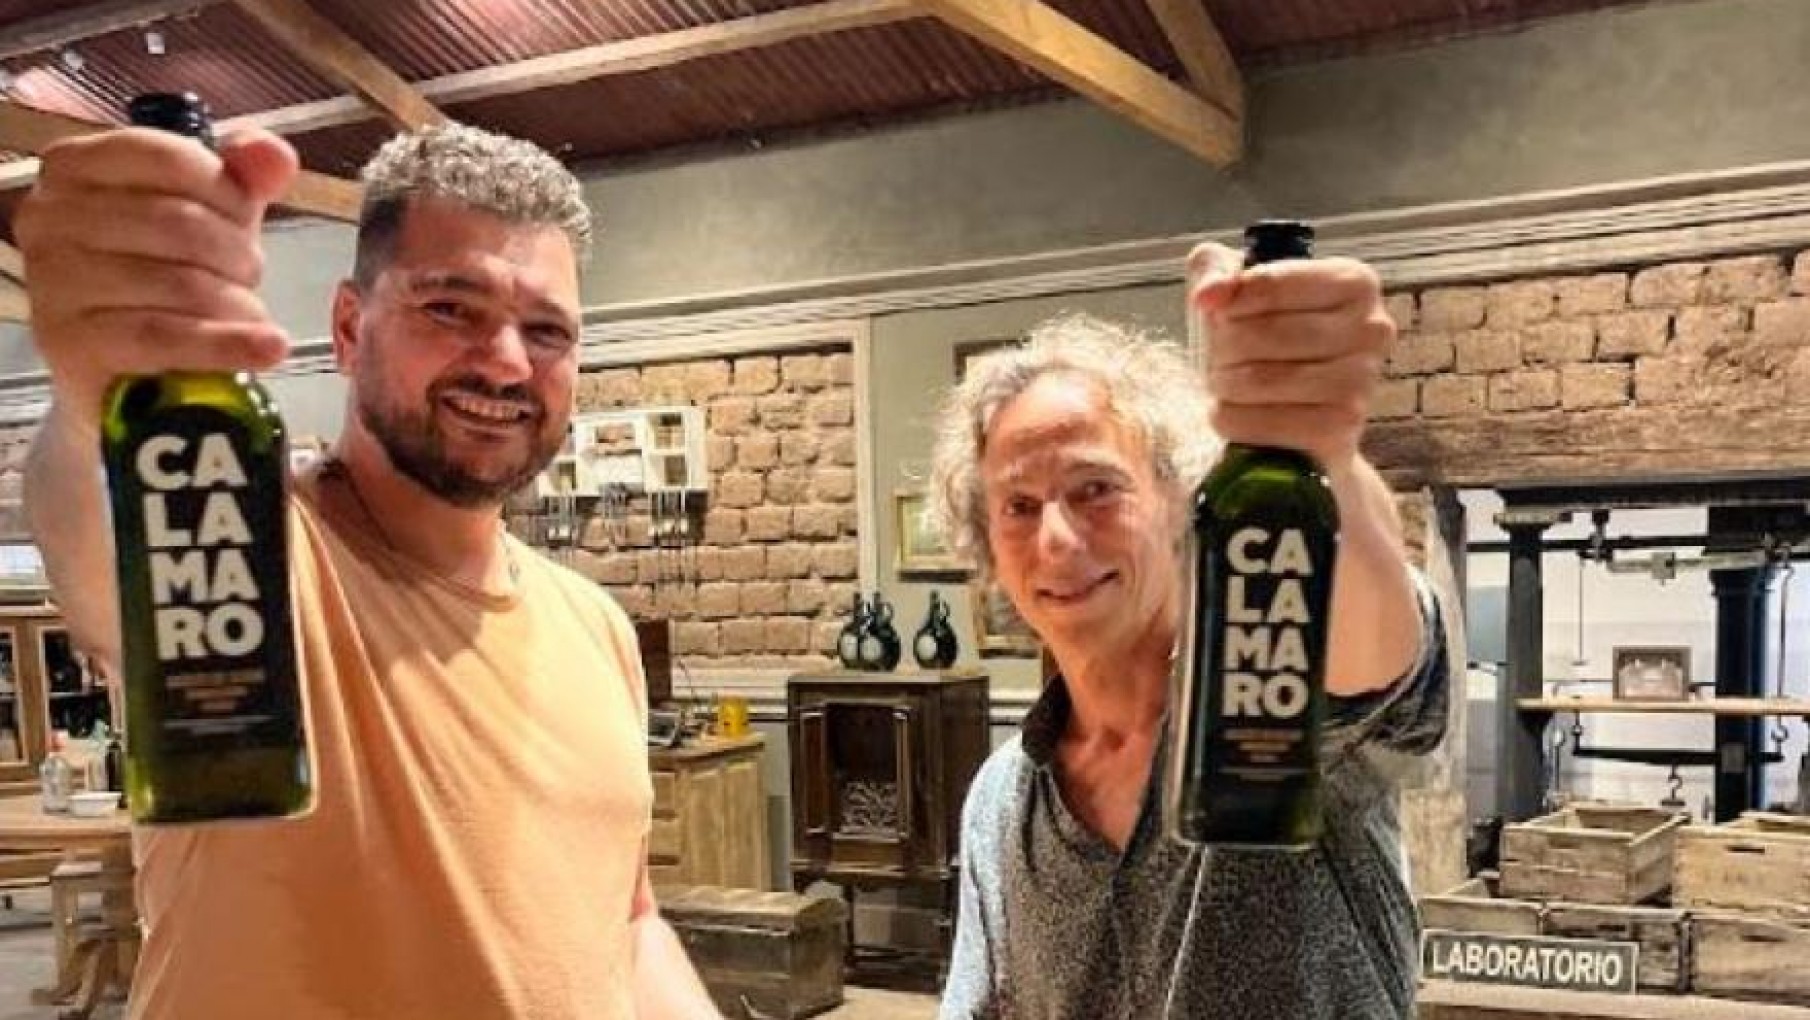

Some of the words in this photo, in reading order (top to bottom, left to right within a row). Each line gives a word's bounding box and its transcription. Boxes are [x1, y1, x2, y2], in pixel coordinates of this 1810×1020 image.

[136, 432, 248, 490] CA
[144, 491, 254, 547] LA
[148, 548, 260, 604] MA
[1226, 527, 1314, 576] CA
[1228, 576, 1311, 623] LA
[155, 604, 264, 660] RO
[1224, 625, 1309, 671] MA
[1221, 673, 1309, 718] RO
[1432, 941, 1623, 985] LABORATORIO
